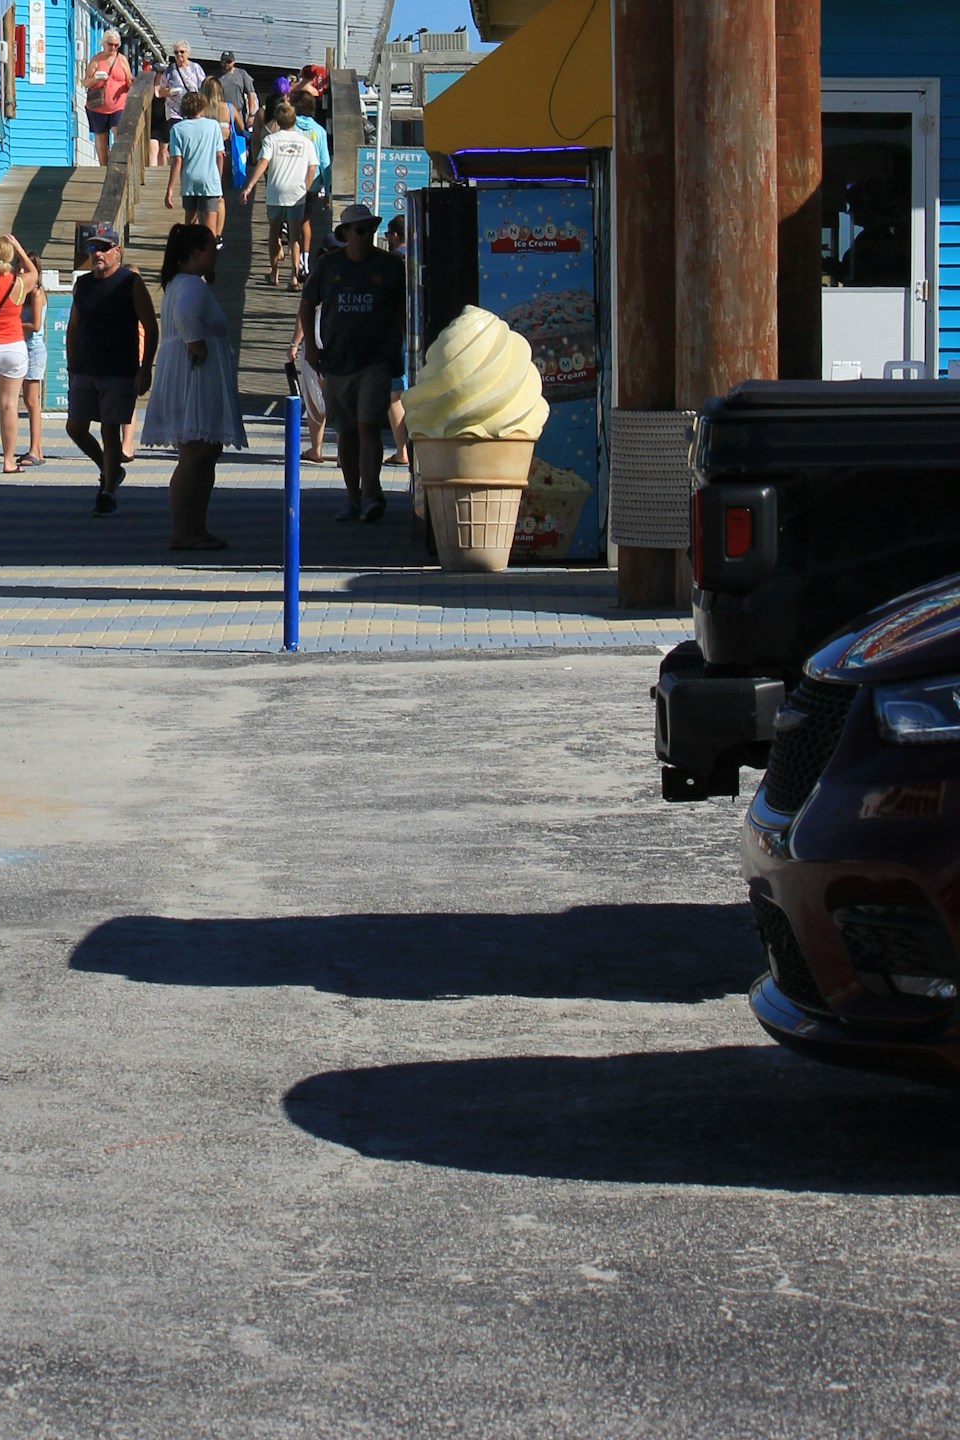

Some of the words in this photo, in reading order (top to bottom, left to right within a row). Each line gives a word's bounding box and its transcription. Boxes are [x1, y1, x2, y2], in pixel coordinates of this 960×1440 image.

[366, 152, 387, 161] PIR
[389, 152, 422, 162] SAFETY
[514, 240, 527, 248] Ice
[528, 240, 557, 248] Cream
[338, 293, 374, 304] KING
[338, 304, 373, 312] POWER
[556, 370, 587, 382] Cream
